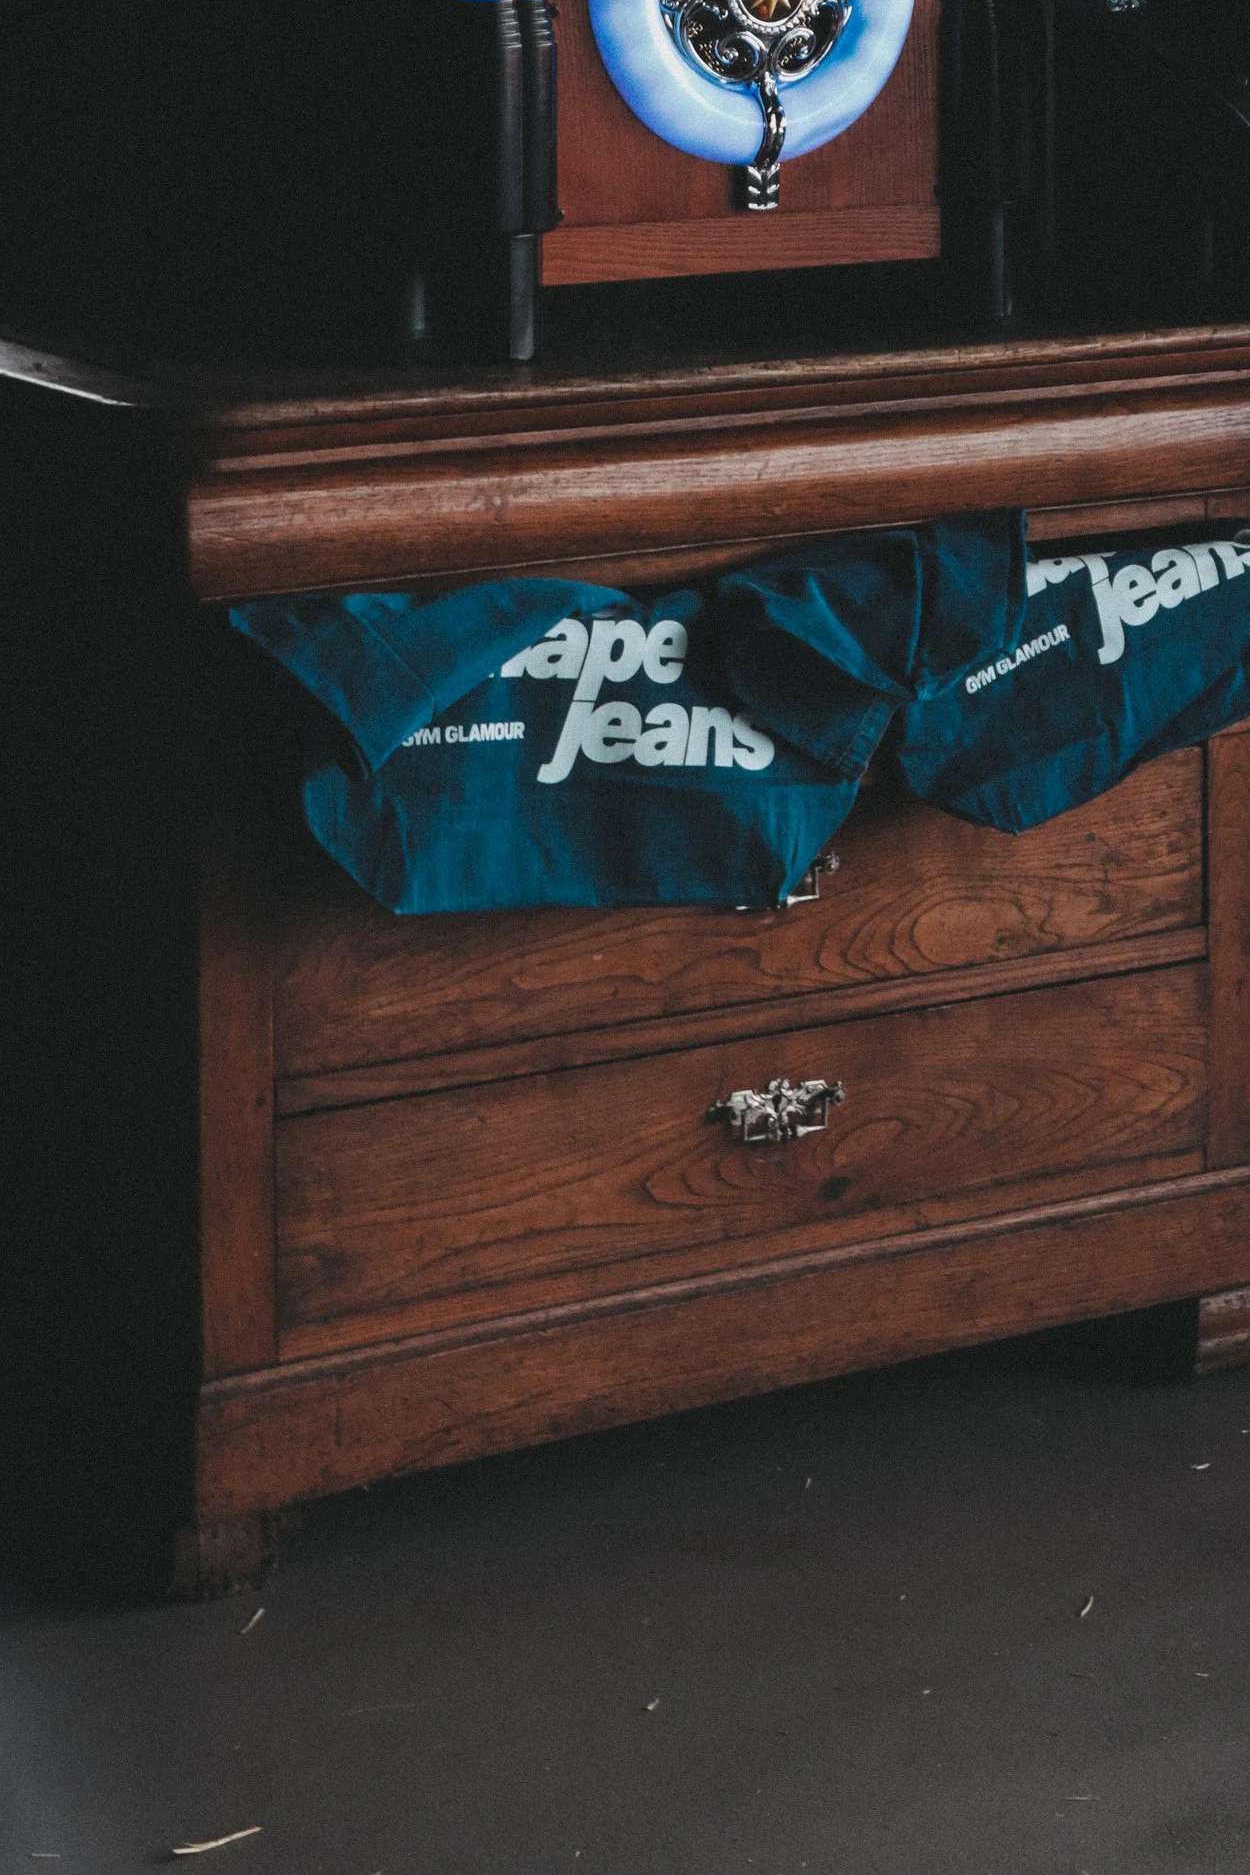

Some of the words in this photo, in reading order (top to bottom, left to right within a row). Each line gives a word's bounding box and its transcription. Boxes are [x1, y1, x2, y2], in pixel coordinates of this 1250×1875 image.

[488, 618, 689, 701] ape
[965, 665, 997, 695] GYM
[996, 623, 1071, 675] GLAMOUR
[444, 721, 526, 744] GLAMOUR
[536, 700, 775, 785] jeans
